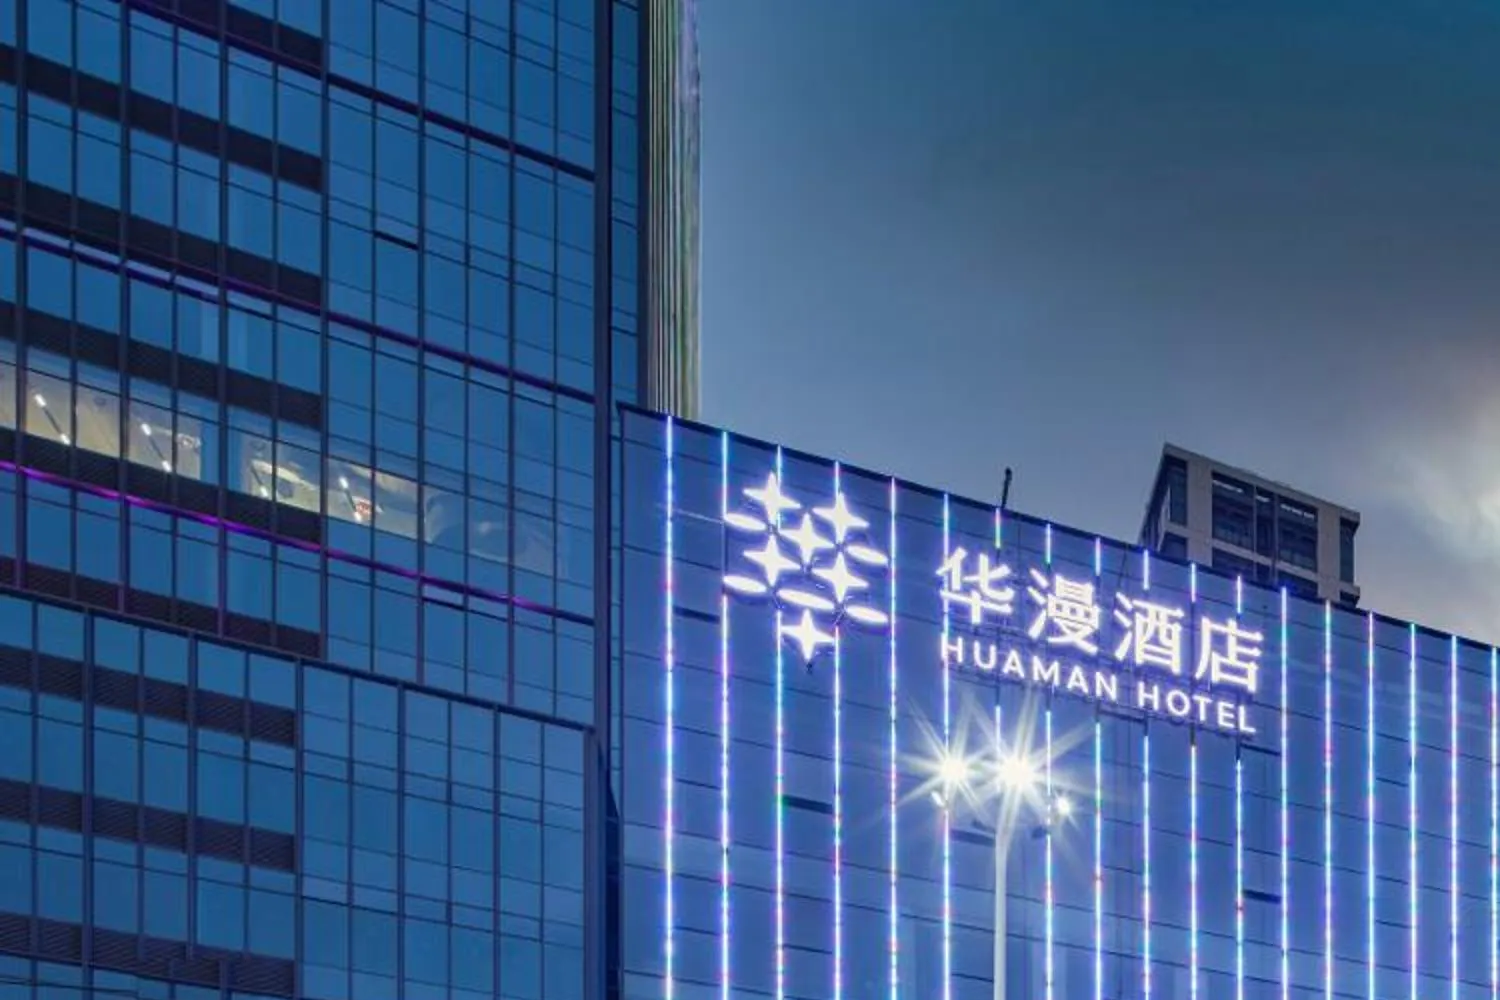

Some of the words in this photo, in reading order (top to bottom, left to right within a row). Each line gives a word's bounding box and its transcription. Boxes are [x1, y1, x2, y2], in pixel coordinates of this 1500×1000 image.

[936, 546, 1264, 692] 华漫酒店
[941, 634, 1117, 701] HUAMAN
[1138, 681, 1257, 734] HOTEL
